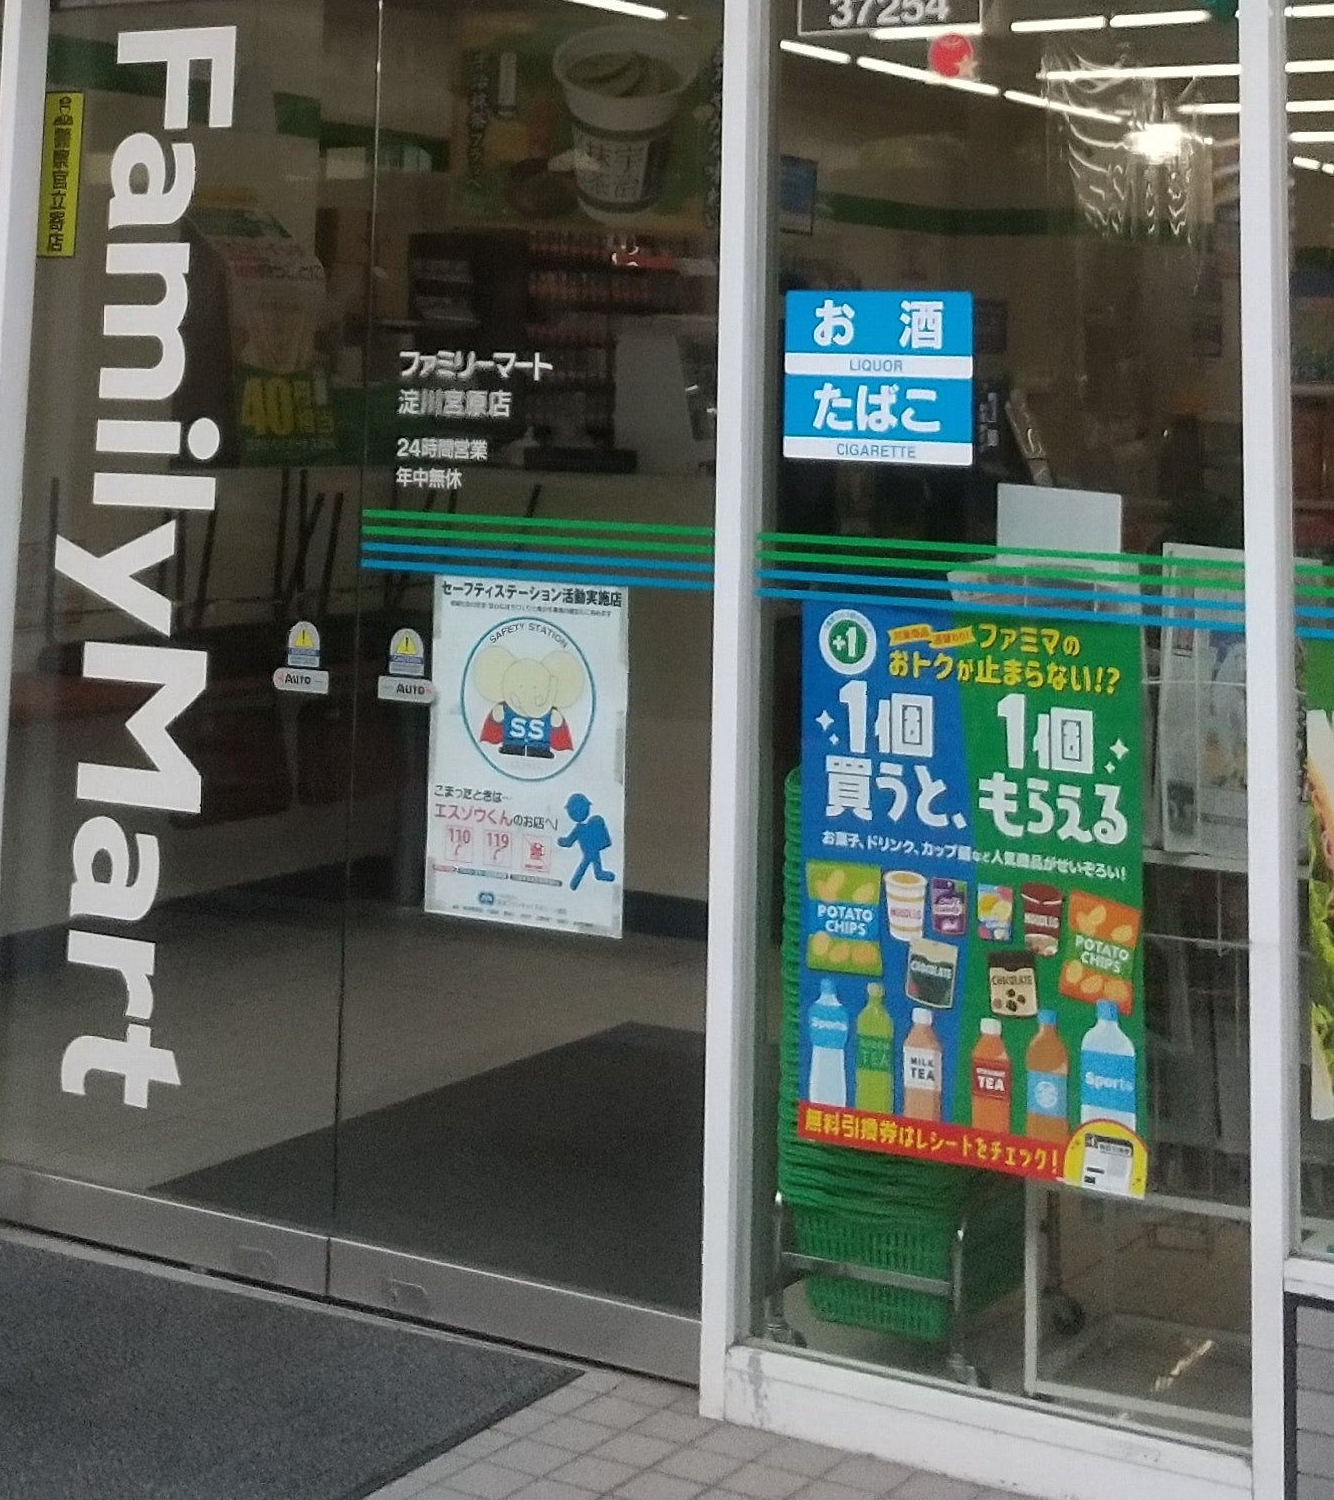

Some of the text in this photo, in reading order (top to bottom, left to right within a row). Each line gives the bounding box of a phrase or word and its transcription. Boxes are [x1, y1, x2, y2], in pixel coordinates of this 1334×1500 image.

[812, 299, 944, 350] お酒
[399, 350, 554, 382] ファミリーマート
[849, 358, 904, 373] LIQUOR
[397, 388, 513, 418] 淀川宮原店
[812, 383, 942, 433] たばこ
[396, 437, 488, 461] 24時間営業
[836, 443, 917, 460] CIGARETTE
[395, 466, 463, 489] 年中無休
[55, 26, 237, 1109] FamilyMart
[441, 580, 623, 608] セーフティステーション活動実施店
[489, 623, 569, 649] SAFETY STATION
[978, 623, 1081, 657] ファミマの
[888, 650, 1121, 695] おトクが止まらない!?
[509, 717, 545, 740] SS
[825, 758, 967, 831] 買うと、
[977, 772, 1128, 845] もらえる
[448, 828, 472, 844] 110
[486, 832, 509, 848] 119
[817, 904, 873, 922] POTATO
[825, 919, 867, 936] CHIPS
[1074, 935, 1129, 961] POTATO
[1080, 951, 1122, 974] CHIPS
[991, 974, 1033, 986] CHOCOLATE
[910, 1056, 934, 1068] MILK
[909, 1067, 936, 1082] TEA
[978, 1076, 1005, 1091] TEA
[1085, 1071, 1134, 1092] Sports
